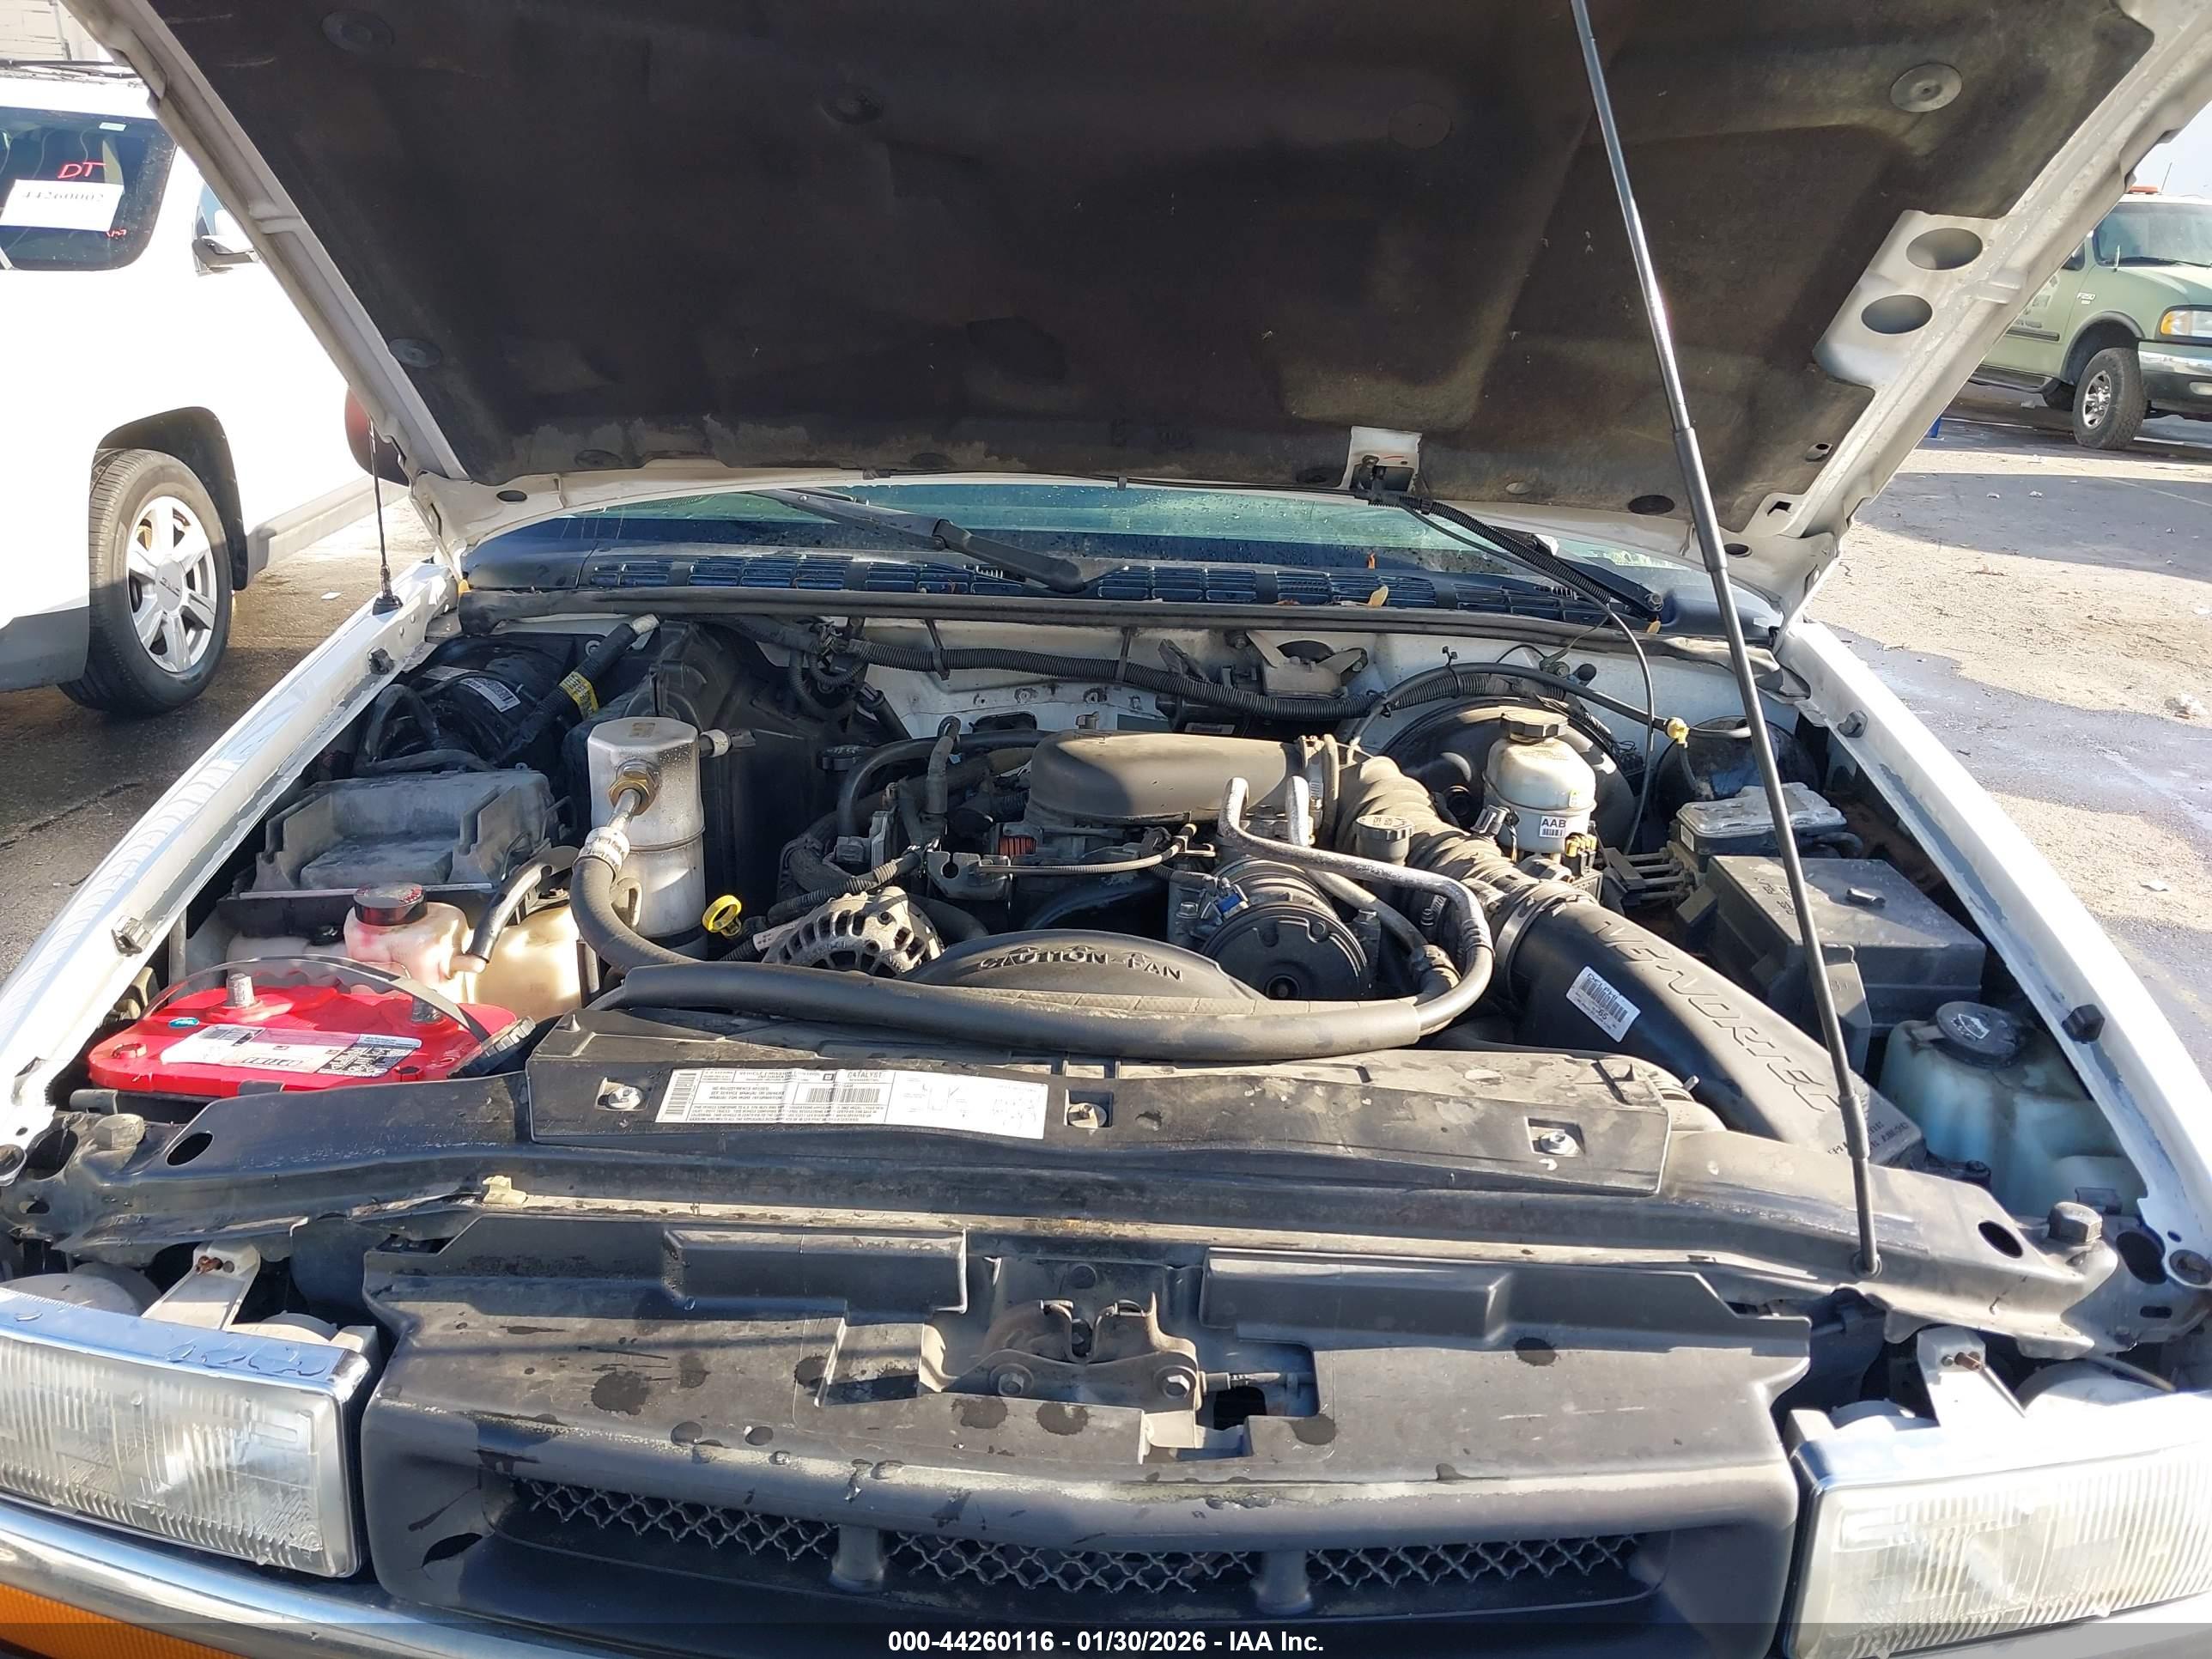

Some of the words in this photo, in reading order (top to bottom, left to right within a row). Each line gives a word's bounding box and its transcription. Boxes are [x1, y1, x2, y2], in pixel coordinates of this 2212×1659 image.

[1541, 818, 1566, 828] AAB
[980, 946, 1109, 969] CAUTION
[1127, 953, 1183, 982] FAN
